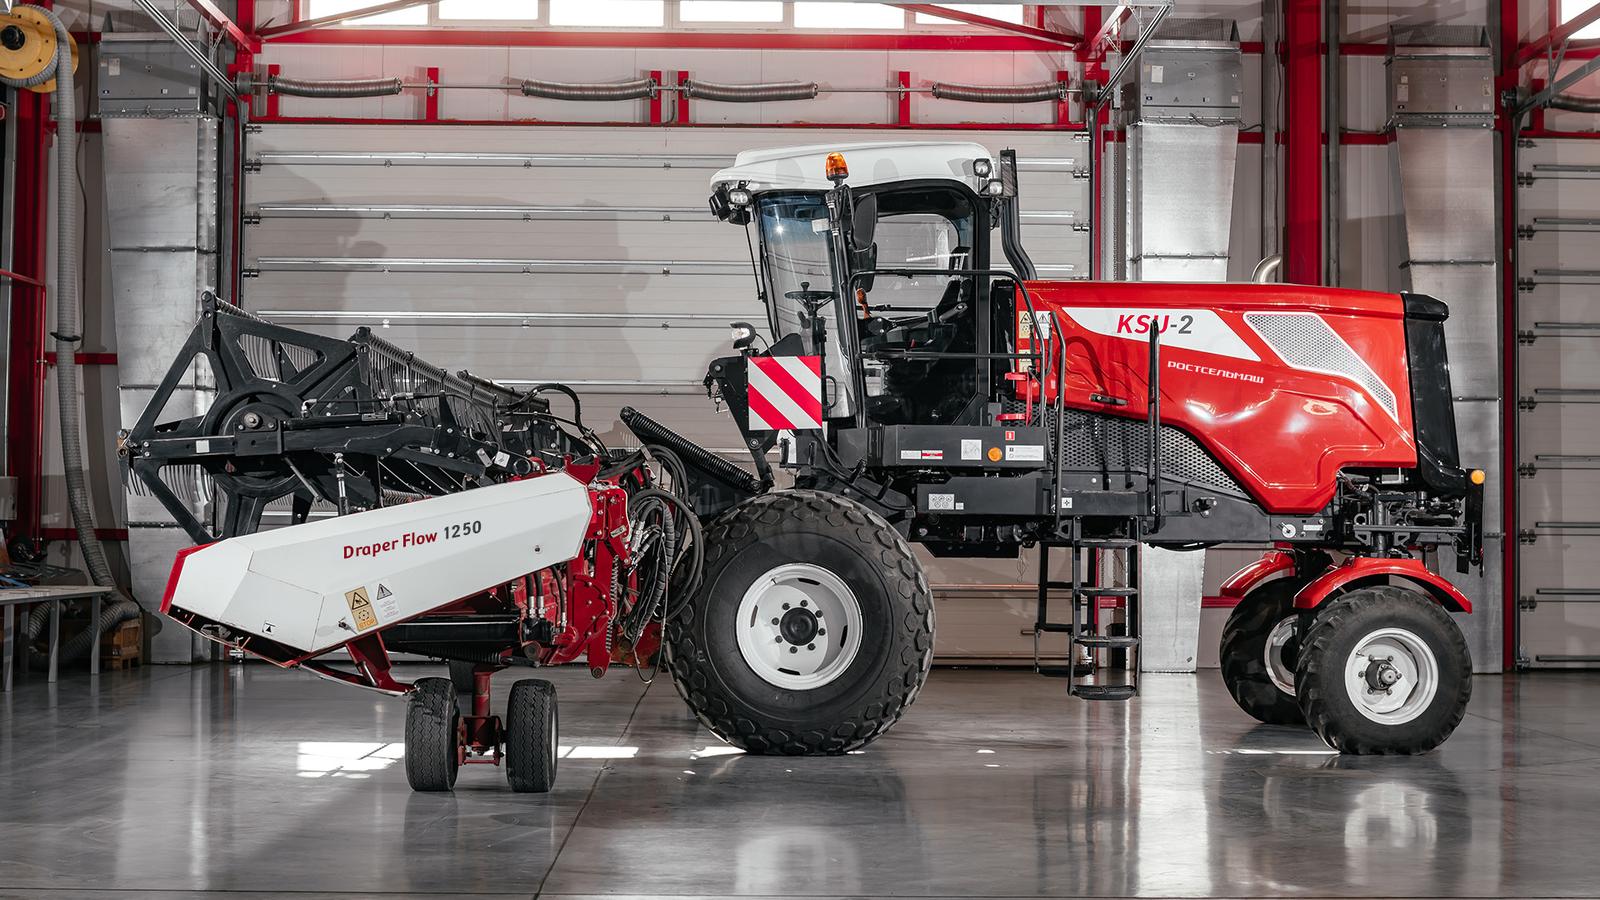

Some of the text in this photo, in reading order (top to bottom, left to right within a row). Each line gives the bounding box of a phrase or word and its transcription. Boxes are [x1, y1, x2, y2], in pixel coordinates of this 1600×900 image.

[1116, 314, 1194, 334] KSU-2
[1167, 360, 1265, 384] РОСТСЕЛЬМАШ
[343, 520, 482, 559] Draper Flow 1250
